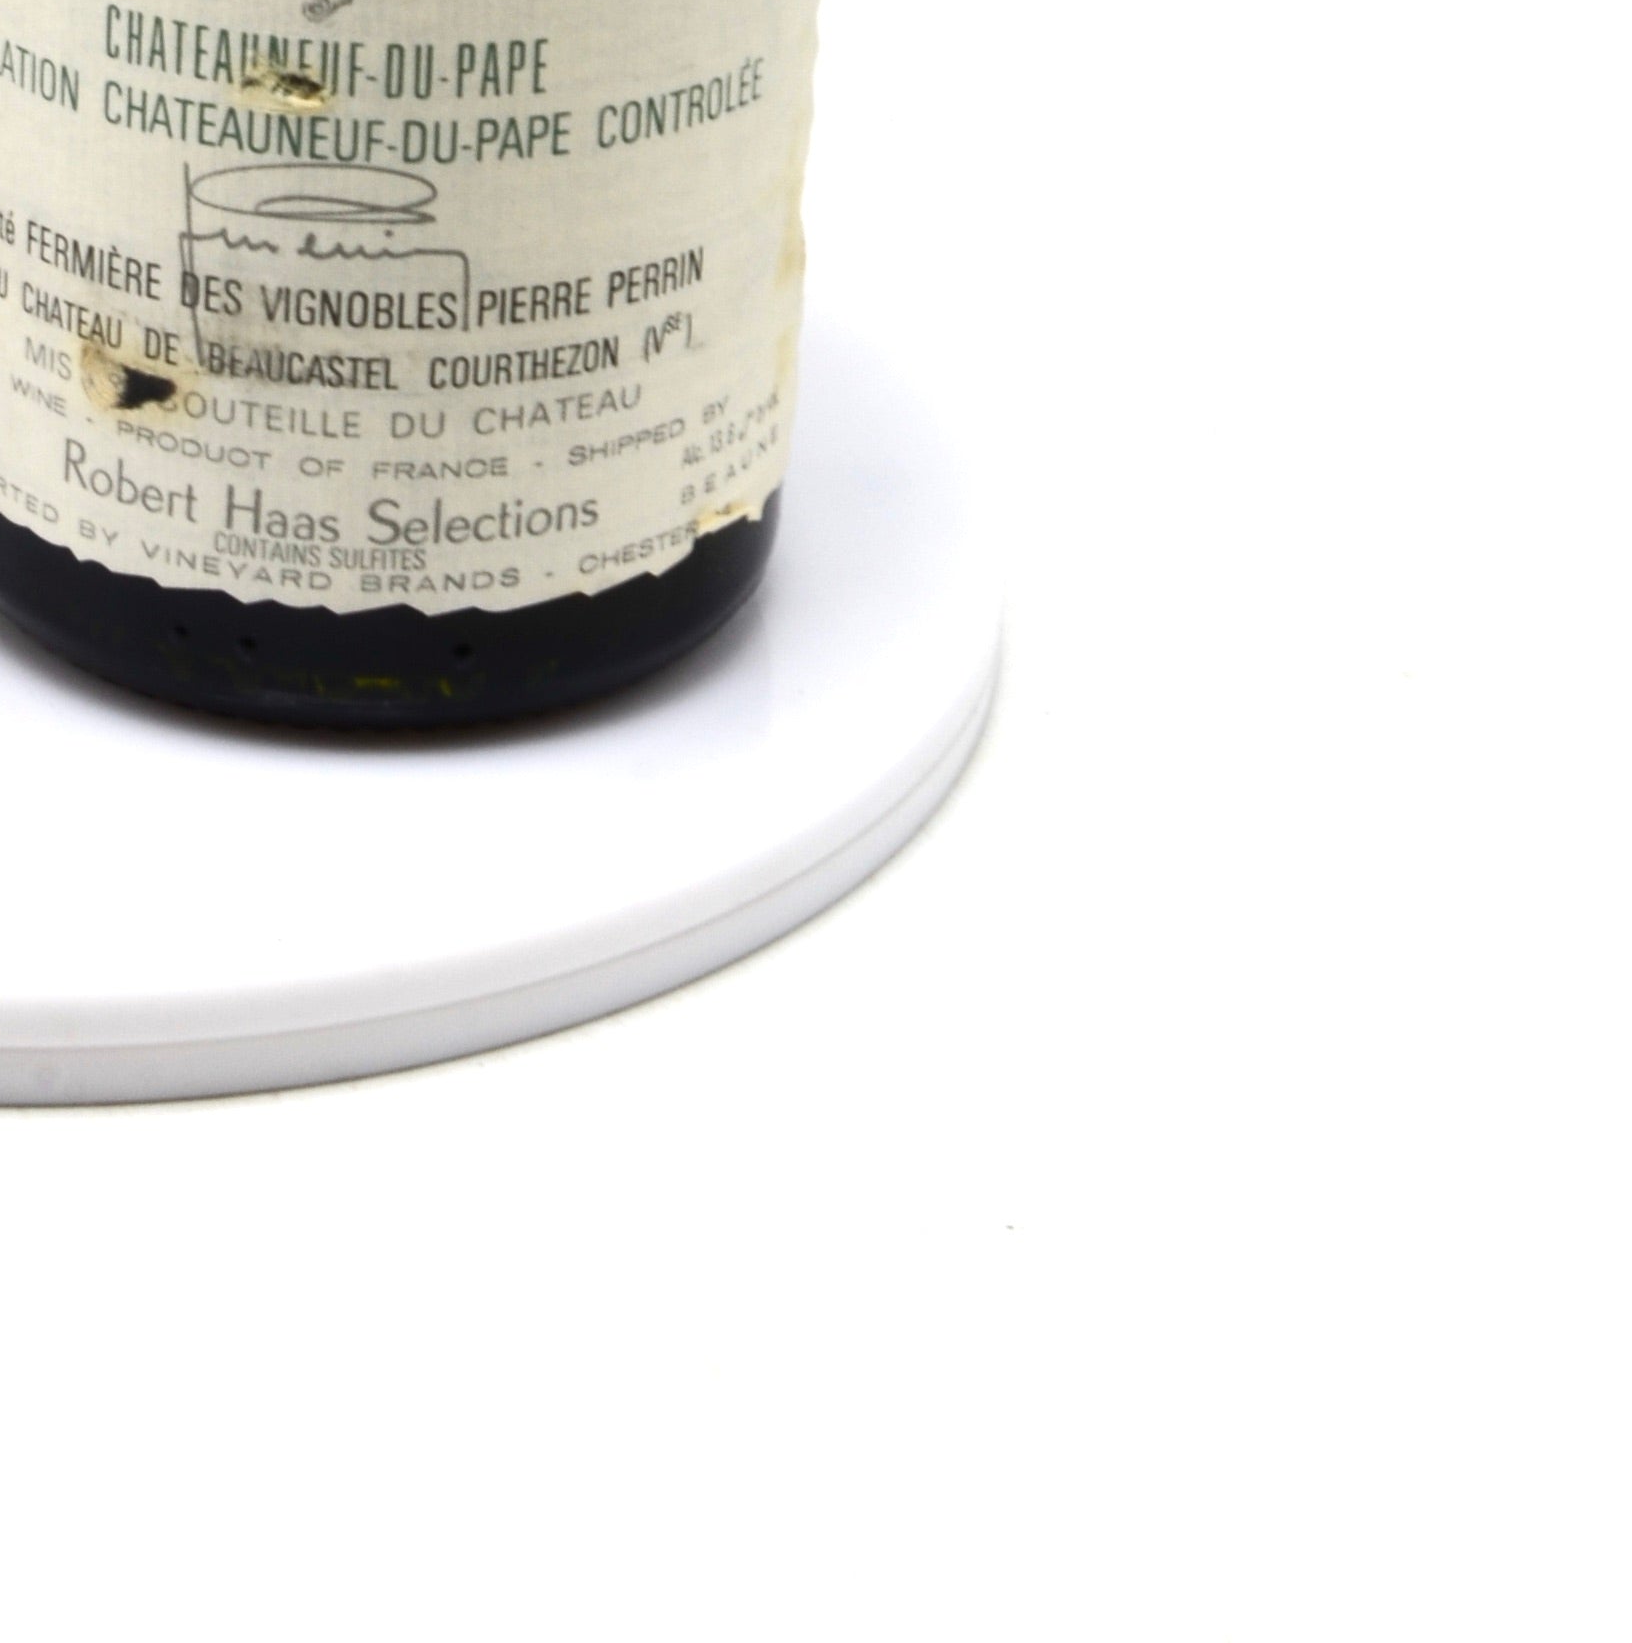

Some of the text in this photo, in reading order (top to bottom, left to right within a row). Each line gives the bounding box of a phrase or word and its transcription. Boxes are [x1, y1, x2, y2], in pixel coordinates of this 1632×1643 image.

[103, 79, 572, 163] CHATEAUNEUF-DU-PAPE
[597, 56, 766, 150] CONTROLÉE
[25, 220, 163, 302] FERMIÈRE
[180, 269, 243, 316] DES
[260, 283, 458, 329] VIGNOBLES
[476, 275, 593, 328] PIERRE
[606, 245, 705, 310] PERRIN
[21, 282, 123, 350] CHATEAU
[143, 326, 180, 366] DE
[208, 339, 399, 389] BEAUCASTEL
[428, 335, 620, 391] COURTHEZON
[23, 336, 643, 440] MIS OUTEILLE DU CHATEAU
[10, 374, 67, 417] WINE
[116, 419, 273, 471] PRODUCT
[298, 456, 346, 478] OF
[370, 456, 509, 481] FRANCE
[566, 418, 686, 468] SHIPPED
[63, 436, 599, 547] Robert Haas Selections
[77, 517, 121, 548] BY
[141, 538, 333, 592] VINEYARD
[360, 566, 522, 595] BRANDS
[576, 518, 702, 575] CHESTER
[214, 530, 427, 571] CONTAINS SULFITES
